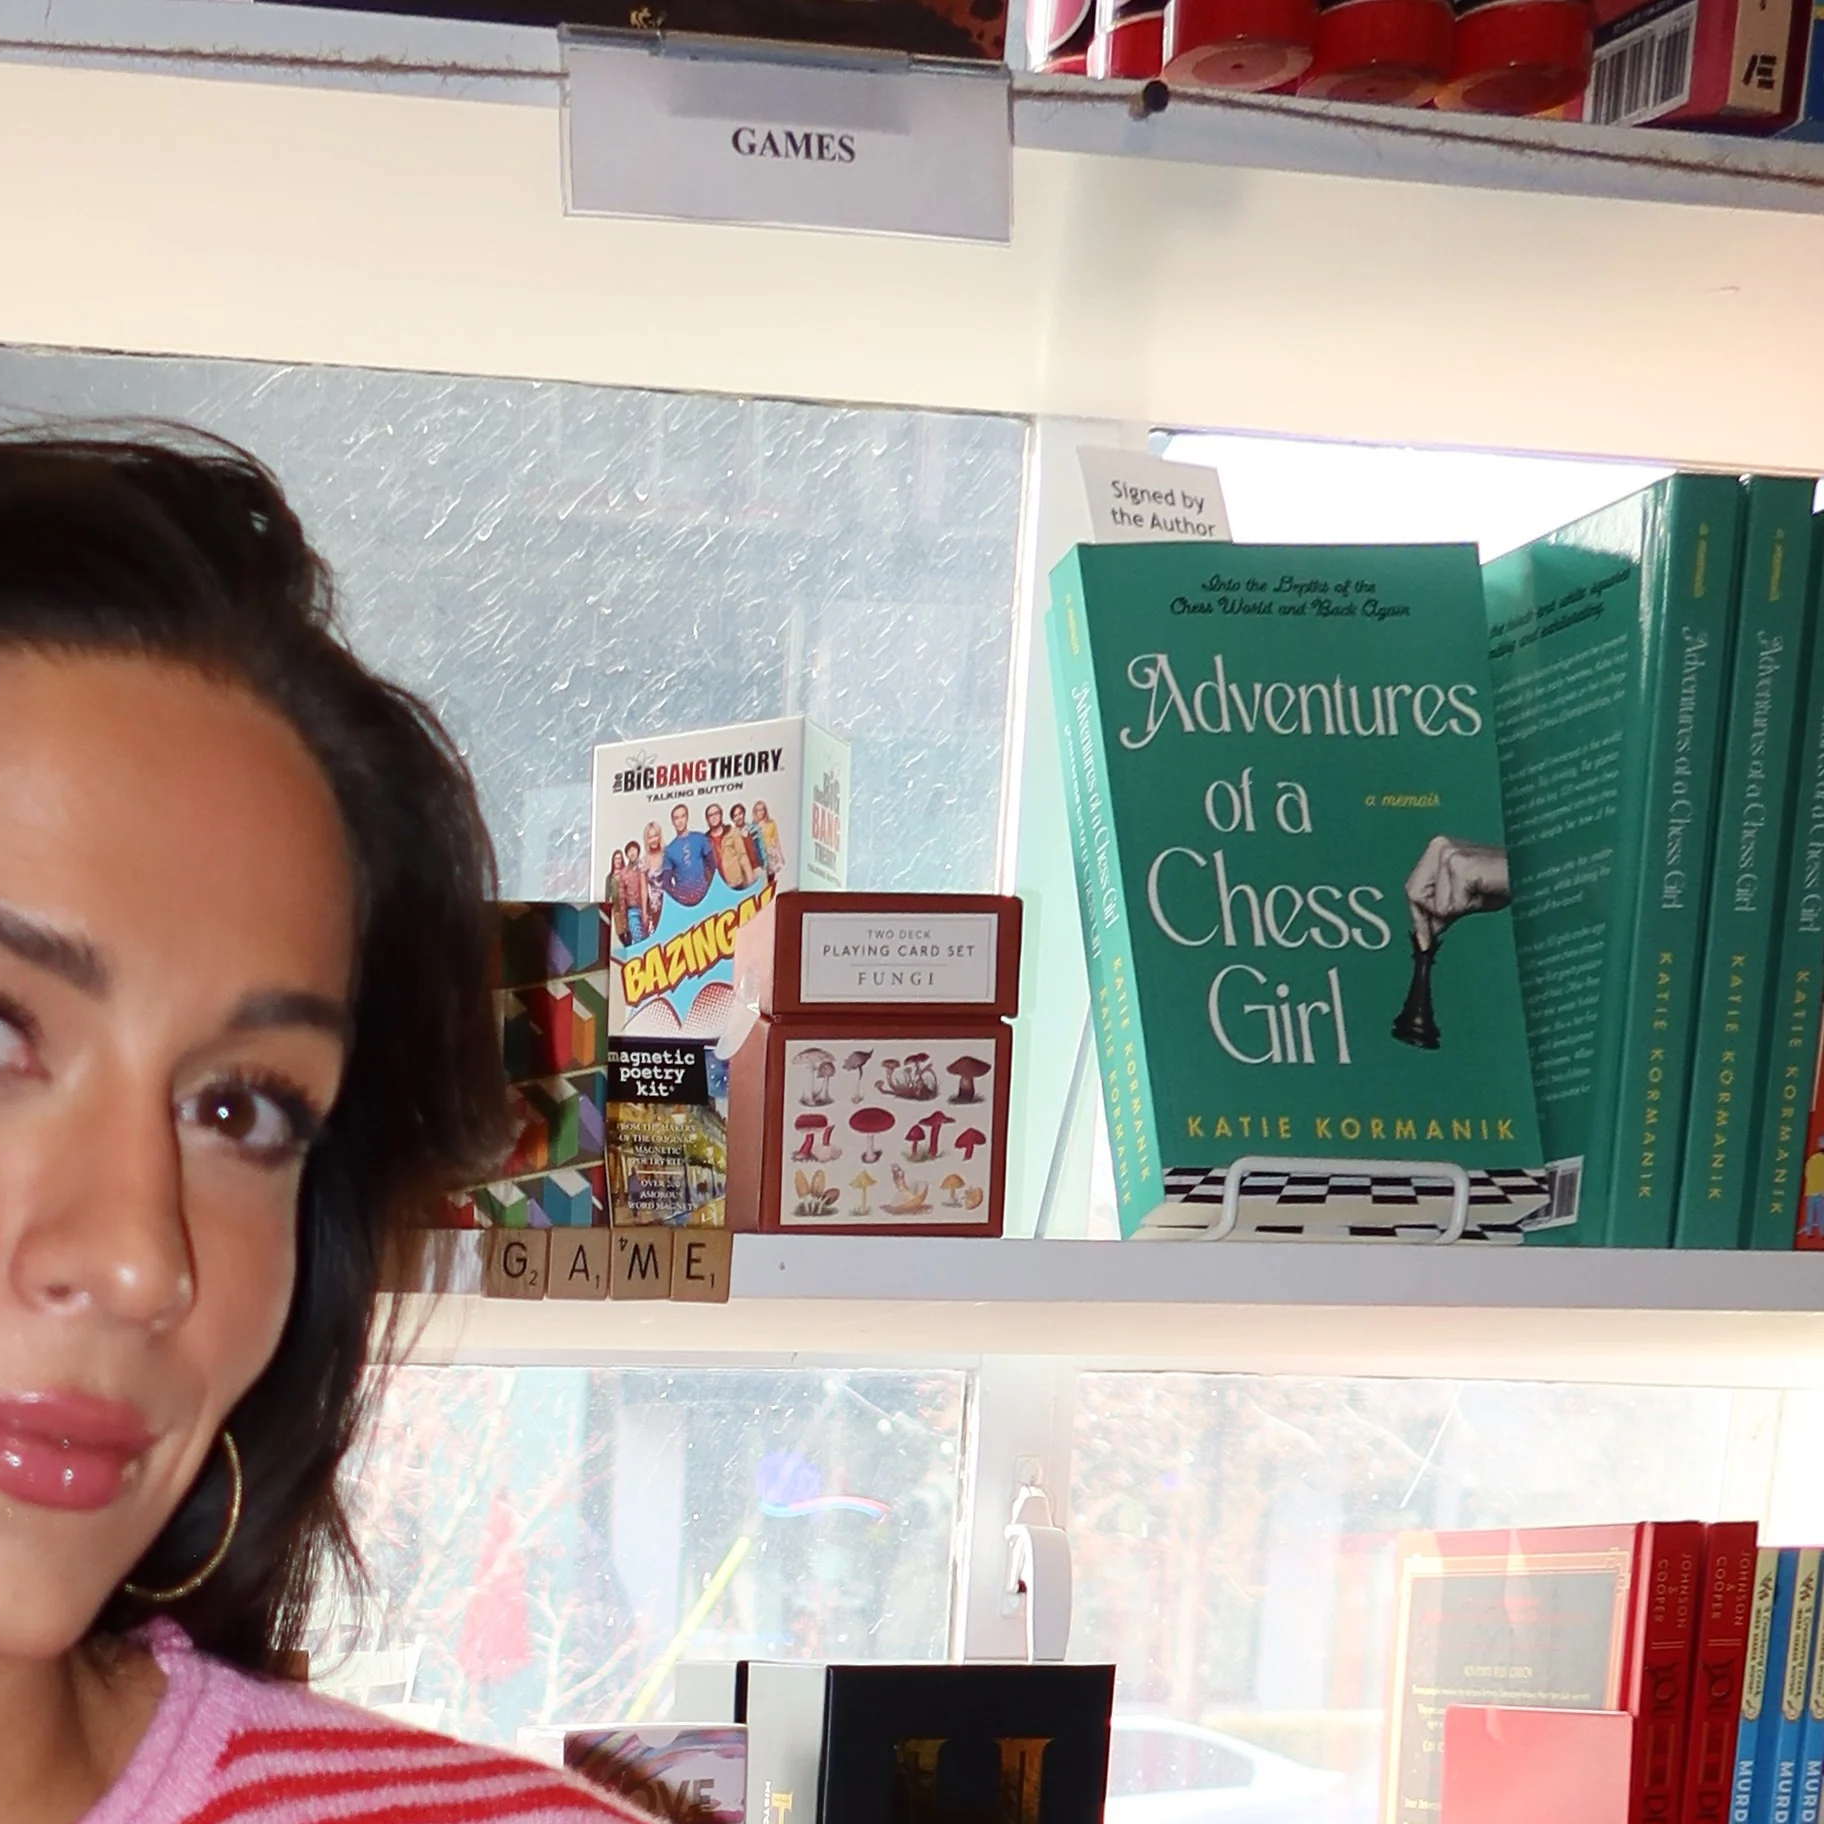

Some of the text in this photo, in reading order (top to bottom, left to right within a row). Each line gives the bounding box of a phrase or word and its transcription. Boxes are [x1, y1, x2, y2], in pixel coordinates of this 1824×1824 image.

[731, 128, 856, 163] GAMES
[1111, 480, 1205, 513] Signed by
[1111, 507, 1216, 538] the Author
[1246, 576, 1266, 593] the
[1334, 578, 1351, 597] of
[1355, 576, 1375, 593] the
[1170, 595, 1410, 621] Chess World and Back Again
[1119, 652, 1483, 750] Adventures
[647, 781, 744, 803] TALKING BUTTON
[1206, 766, 1312, 834] of a
[1147, 846, 1391, 951] Chess
[866, 928, 932, 940] TWO DECK
[822, 944, 975, 959] PLAYING CARD SET
[857, 970, 937, 987] FUNGI
[1207, 964, 1352, 1066] Girl
[608, 1048, 695, 1067] magnetic
[1112, 956, 1150, 1182] KATIE KORMANIK
[620, 1066, 685, 1084] poetry
[636, 1081, 669, 1097] kit
[1638, 952, 1673, 1198] KATIE KORMANIK
[1708, 954, 1746, 1199] KATIE KORMANIK
[1770, 970, 1811, 1214] KATIE KORMANIK
[1188, 1115, 1515, 1142] KATIE KORMANIK
[1653, 1558, 1668, 1622] COOPER
[1677, 1553, 1694, 1628] JOHNSON
[630, 1777, 715, 1812] OVE
